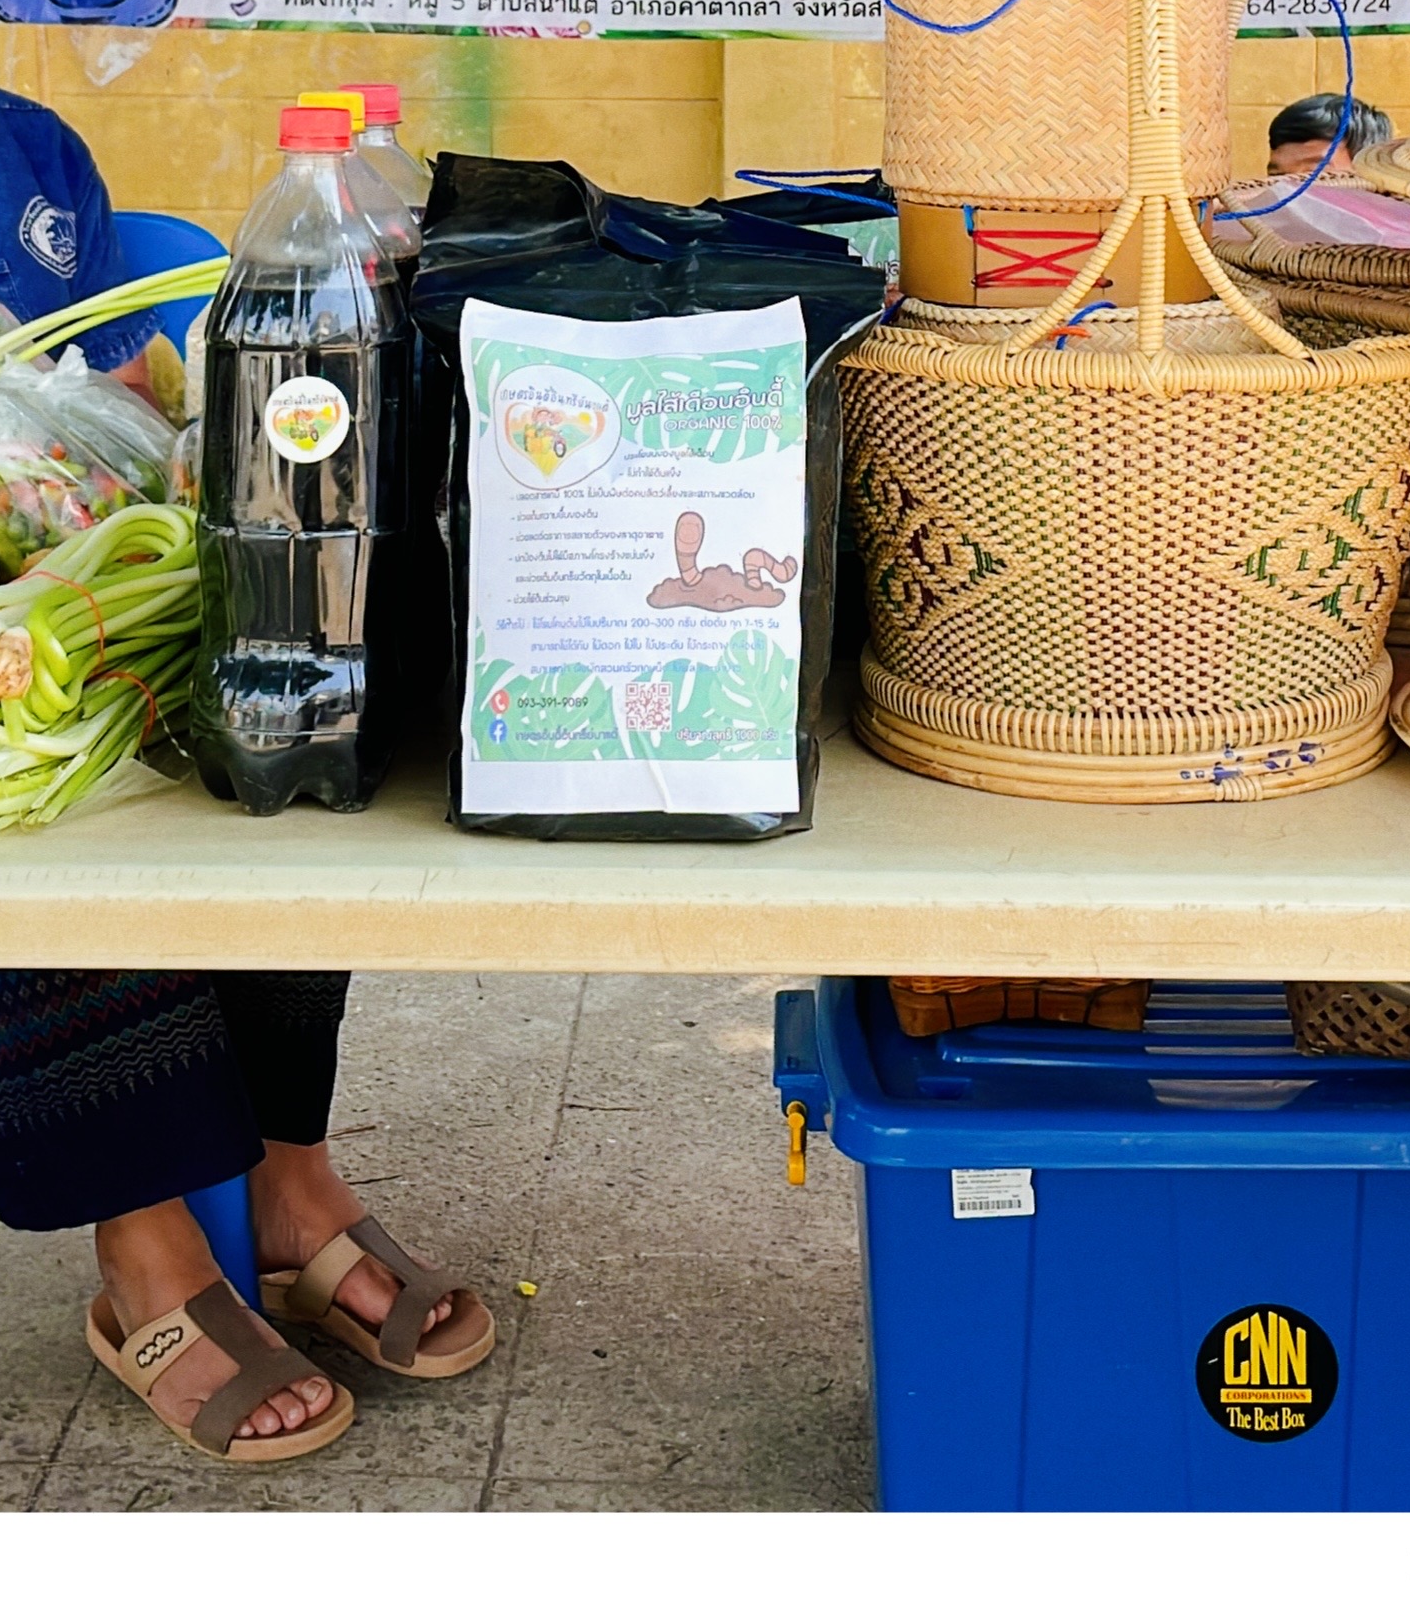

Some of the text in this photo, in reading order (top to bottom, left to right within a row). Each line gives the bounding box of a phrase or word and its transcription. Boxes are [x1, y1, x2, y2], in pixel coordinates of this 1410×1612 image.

[625, 377, 785, 425] มูลไส้เดือนอินดี้
[663, 414, 783, 432] ORGANIC 100%
[630, 618, 675, 629] 200-300
[1224, 1311, 1307, 1385] CNN
[1225, 1390, 1307, 1401] CORPORATIONS
[1226, 1406, 1306, 1431] The Best Box
